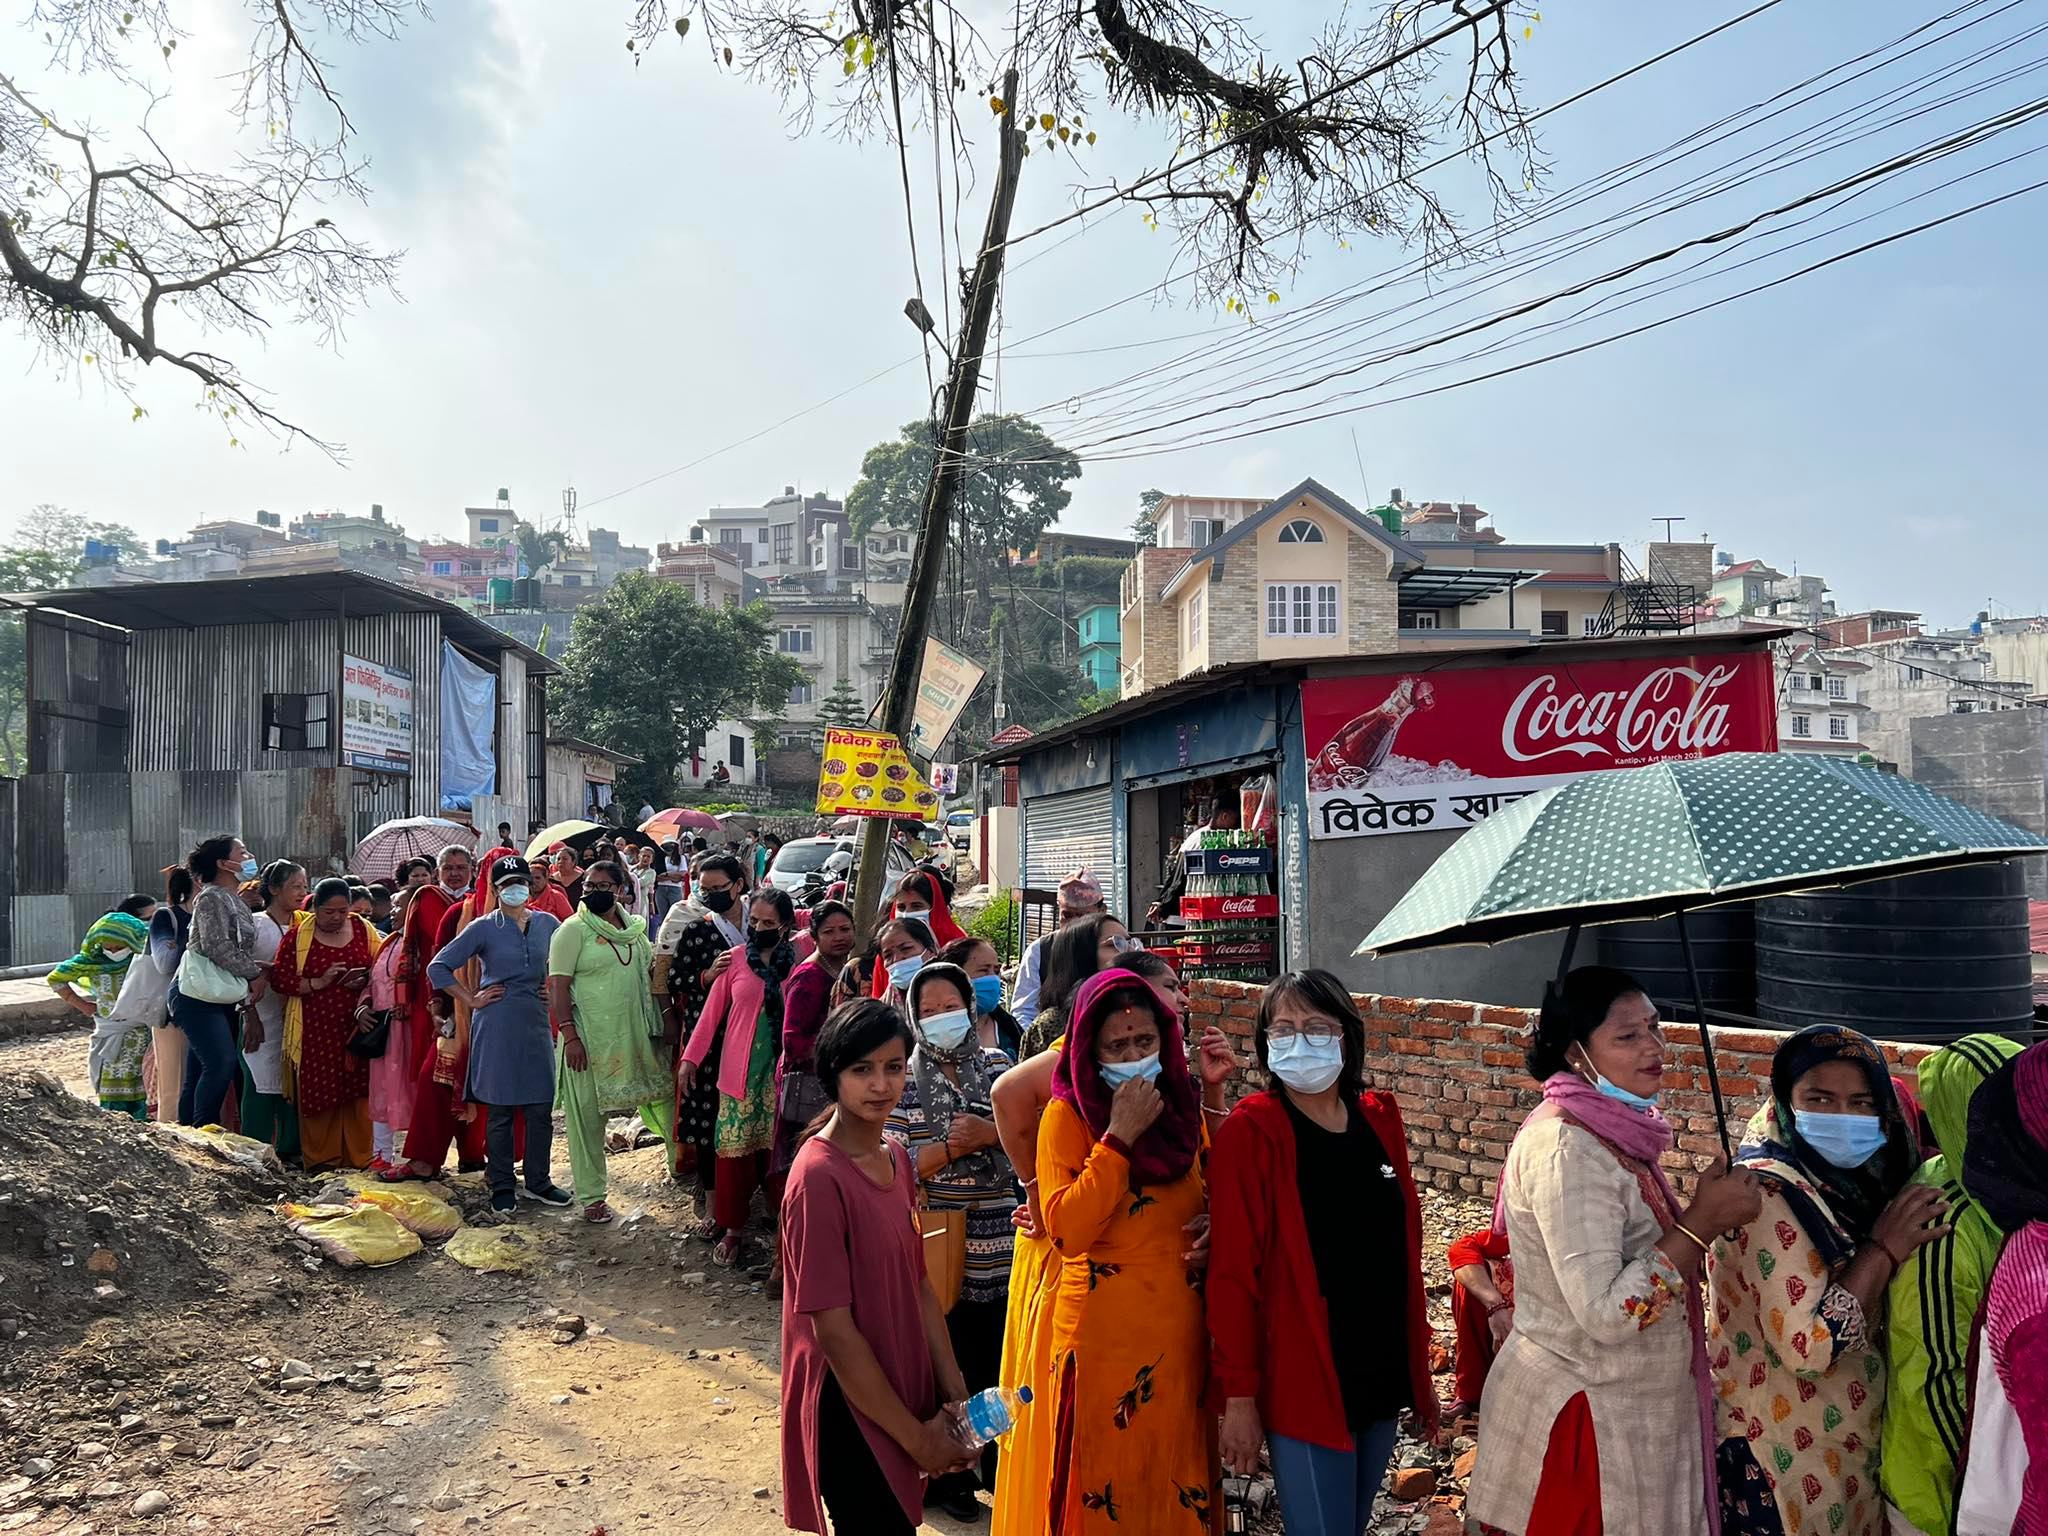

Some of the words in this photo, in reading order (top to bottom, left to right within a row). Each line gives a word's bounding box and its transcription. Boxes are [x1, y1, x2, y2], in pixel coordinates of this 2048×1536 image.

[1502, 664, 1740, 762] Coca-Cola
[1320, 793, 1437, 834] विवेक
[503, 857, 518, 869] NY
[1228, 856, 1260, 865] PEPSI
